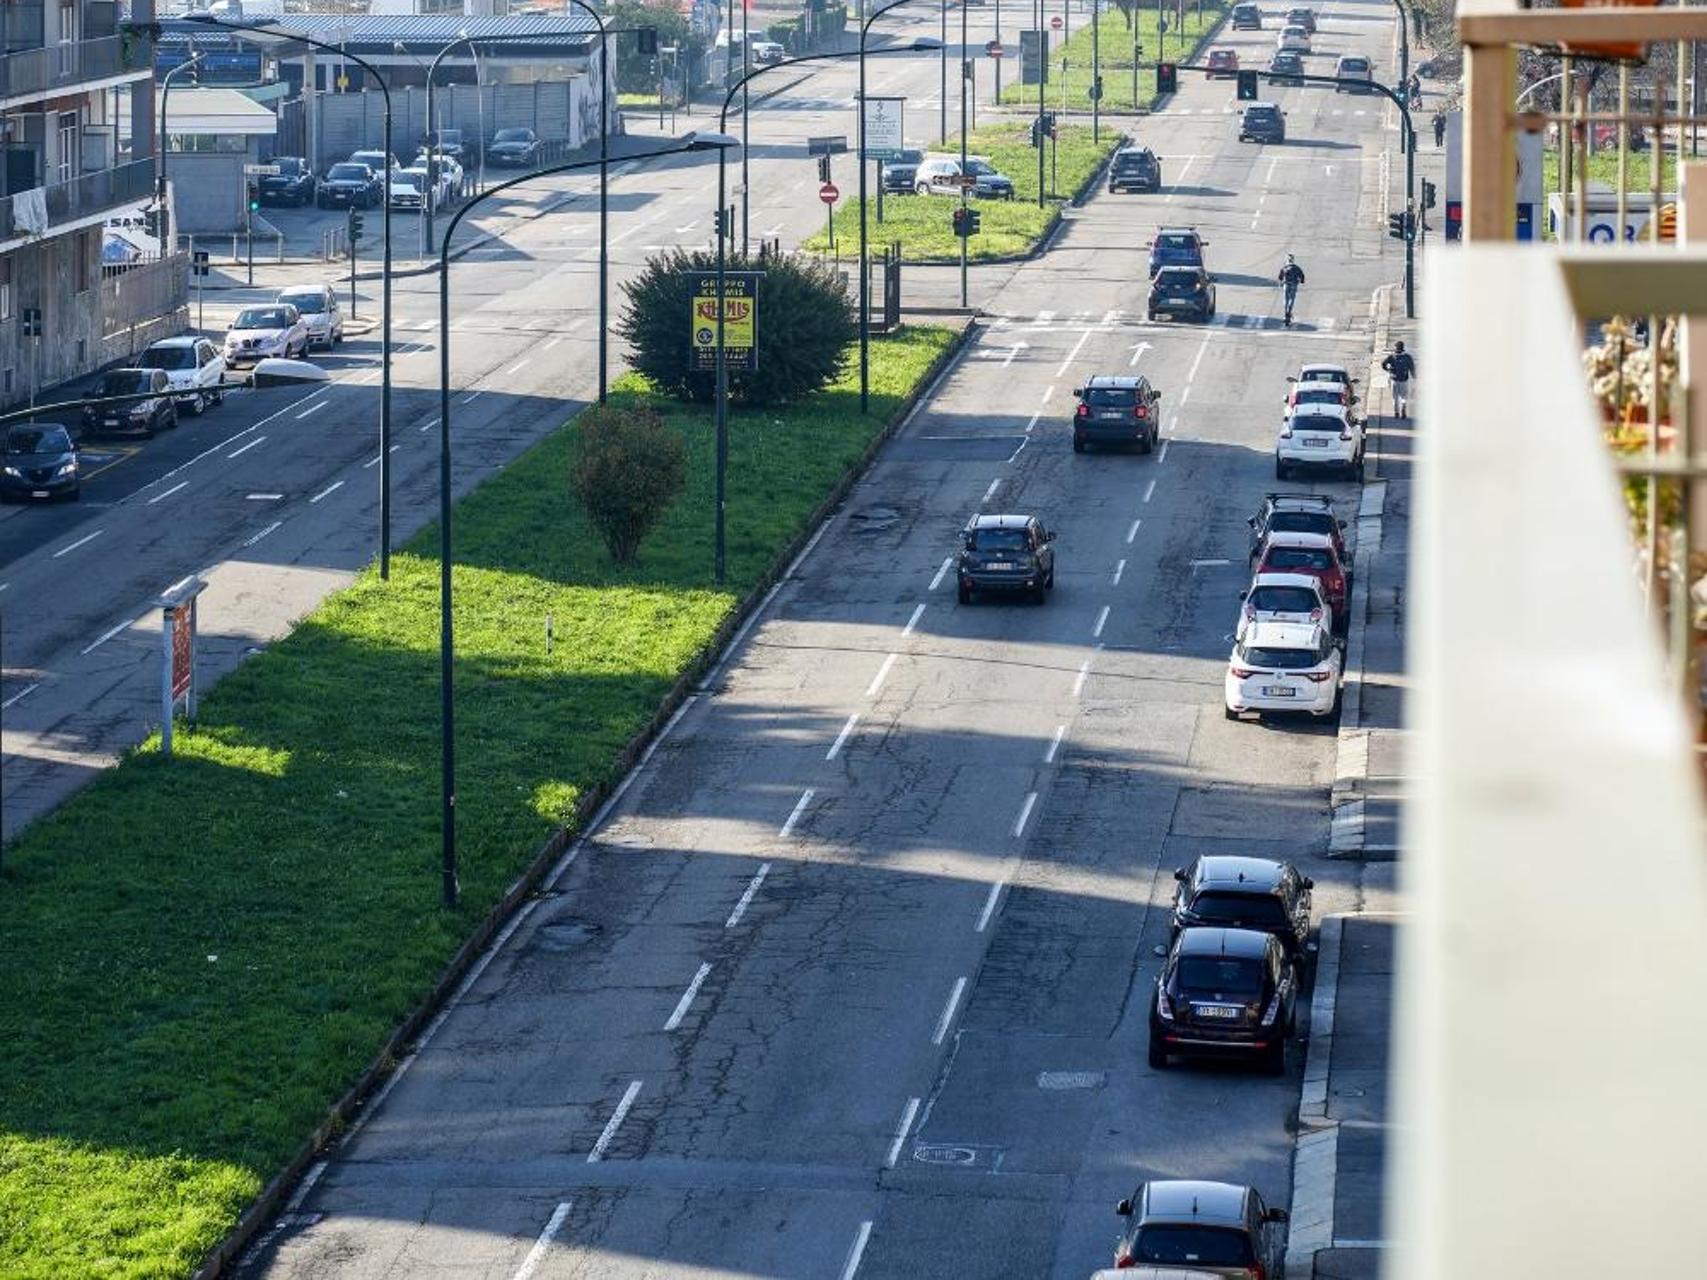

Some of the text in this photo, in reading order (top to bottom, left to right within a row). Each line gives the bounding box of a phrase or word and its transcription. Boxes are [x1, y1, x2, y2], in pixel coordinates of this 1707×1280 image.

[701, 279, 746, 288] GRPPO
[702, 288, 744, 296] KHMIS
[697, 300, 750, 322] KHMIS
